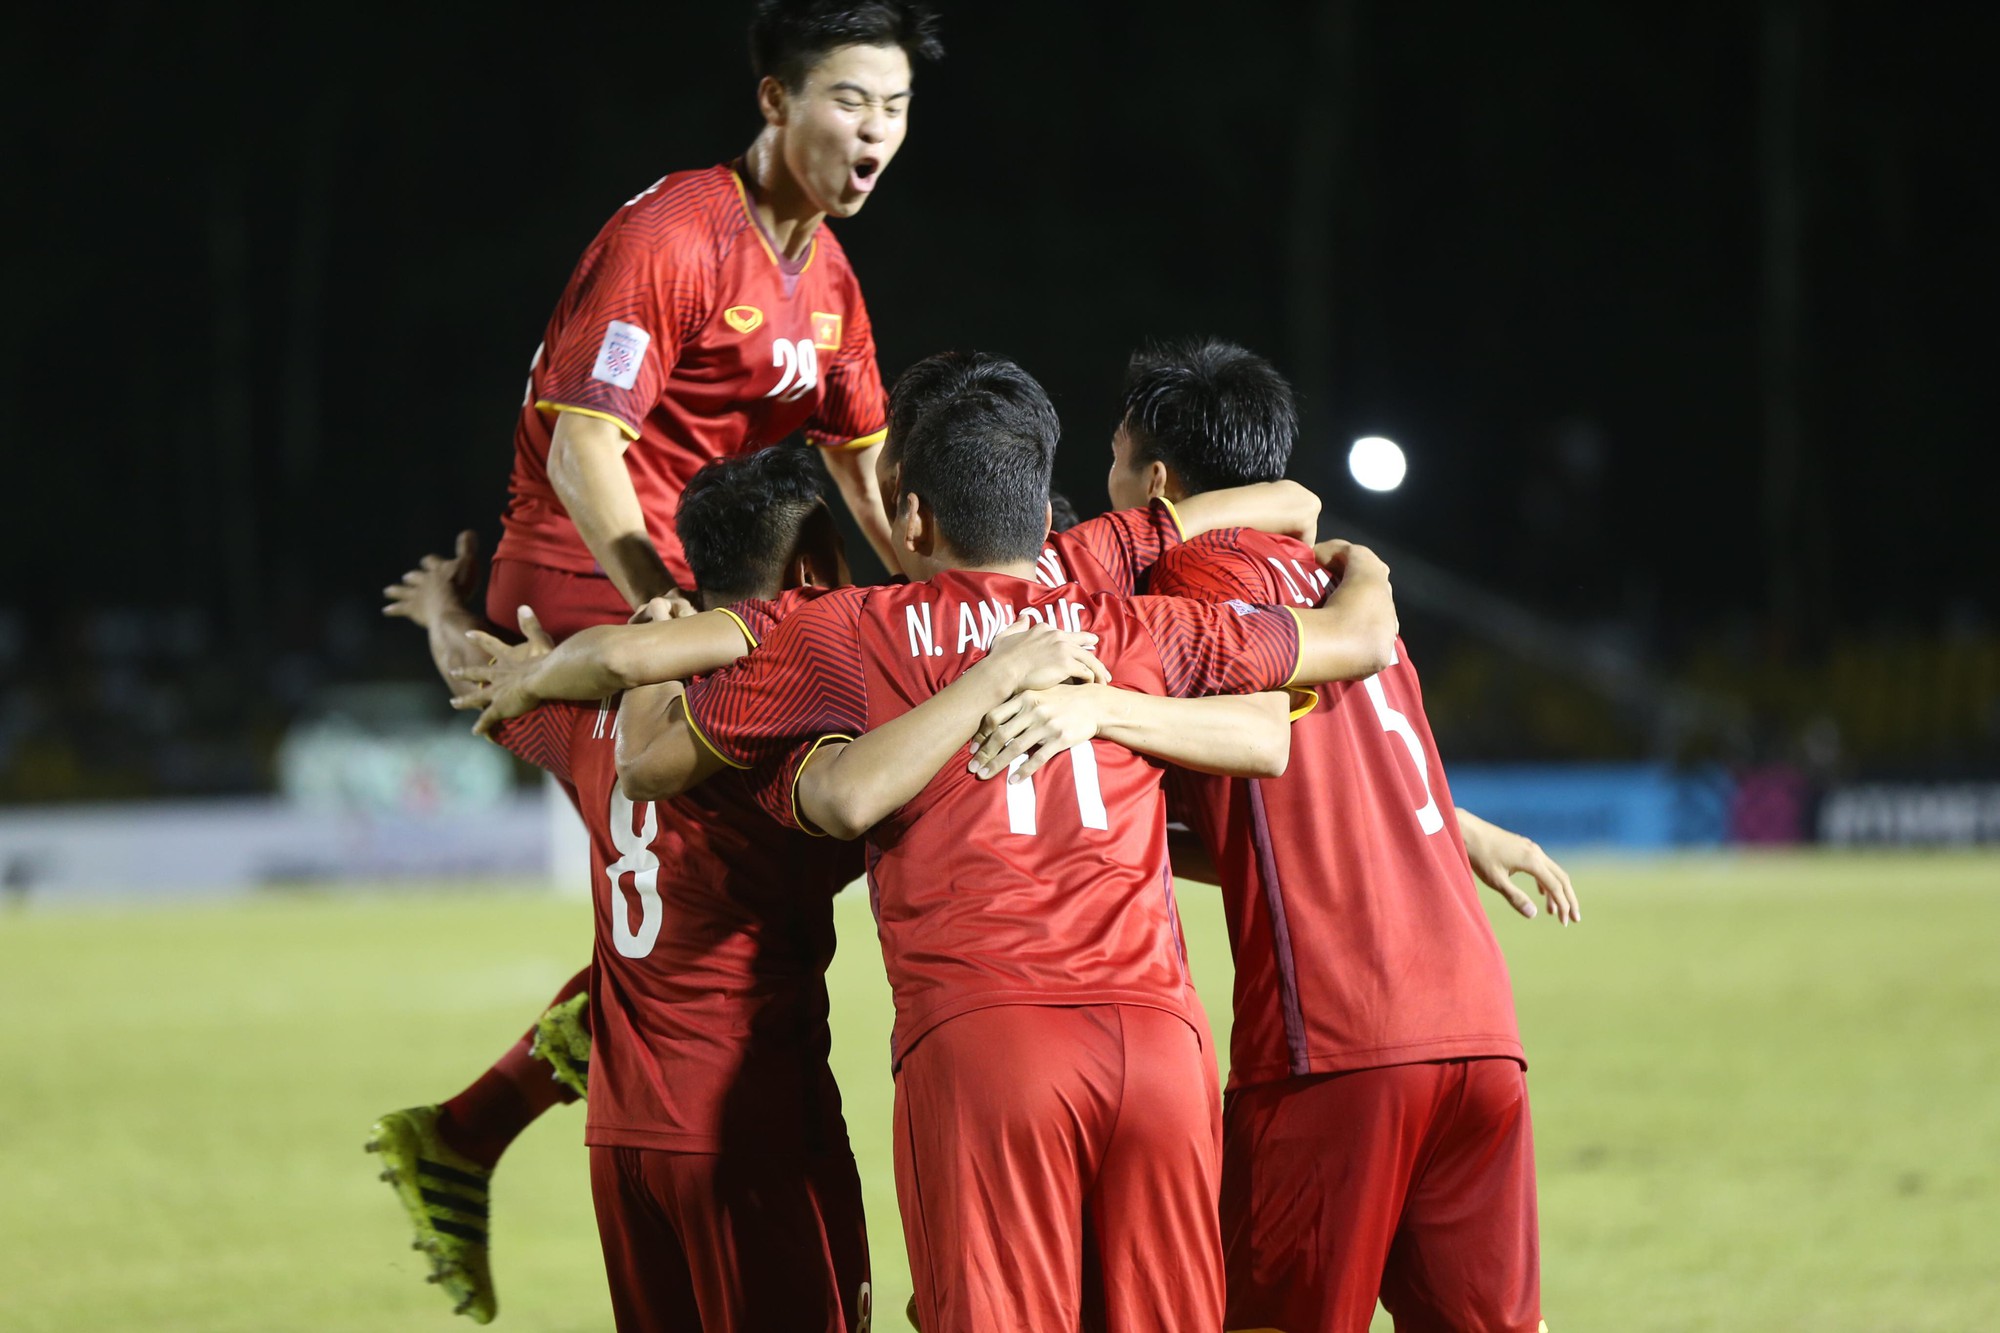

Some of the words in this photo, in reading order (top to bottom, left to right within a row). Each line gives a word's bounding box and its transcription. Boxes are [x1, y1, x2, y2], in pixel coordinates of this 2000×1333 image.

[764, 338, 818, 403] 29
[905, 601, 943, 657] N.
[606, 777, 663, 959] 8
